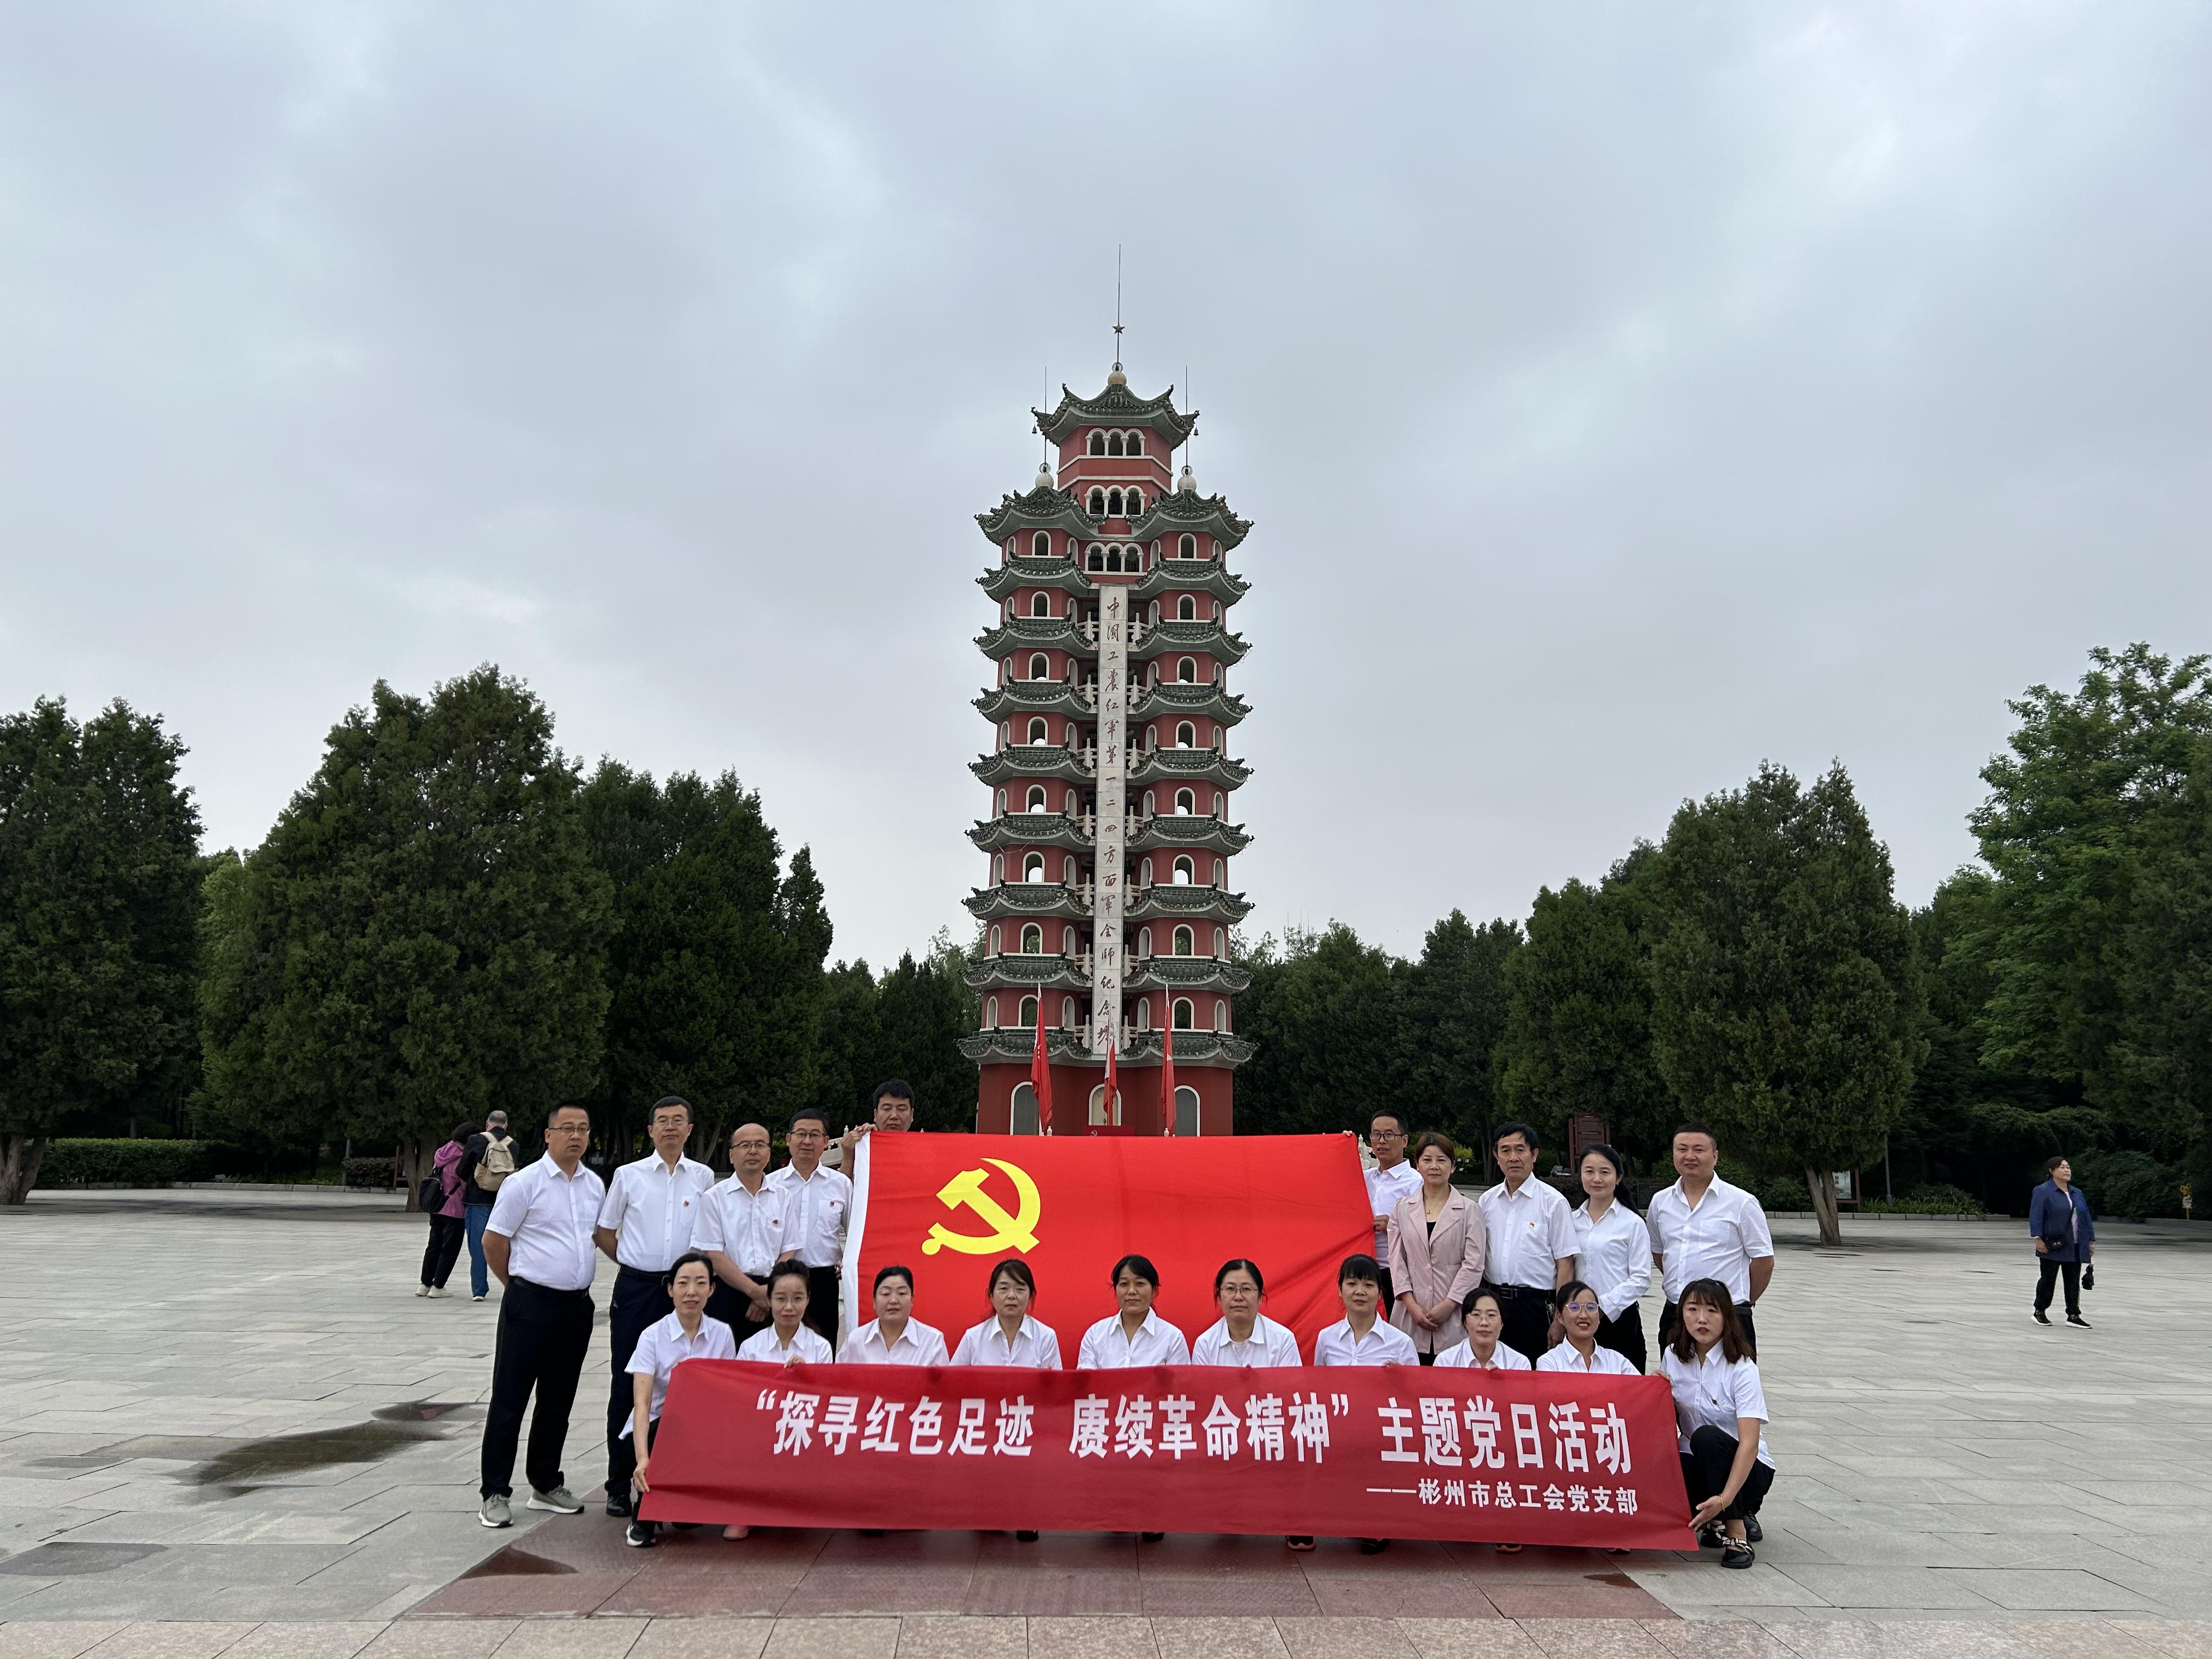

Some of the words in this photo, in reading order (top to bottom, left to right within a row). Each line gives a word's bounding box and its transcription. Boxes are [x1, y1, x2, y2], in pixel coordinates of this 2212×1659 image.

[757, 1389, 1034, 1456] “探寻红色足迹
[1069, 1392, 1348, 1463] 赓续革命精神”
[1378, 1395, 1632, 1475] 主题党日活动
